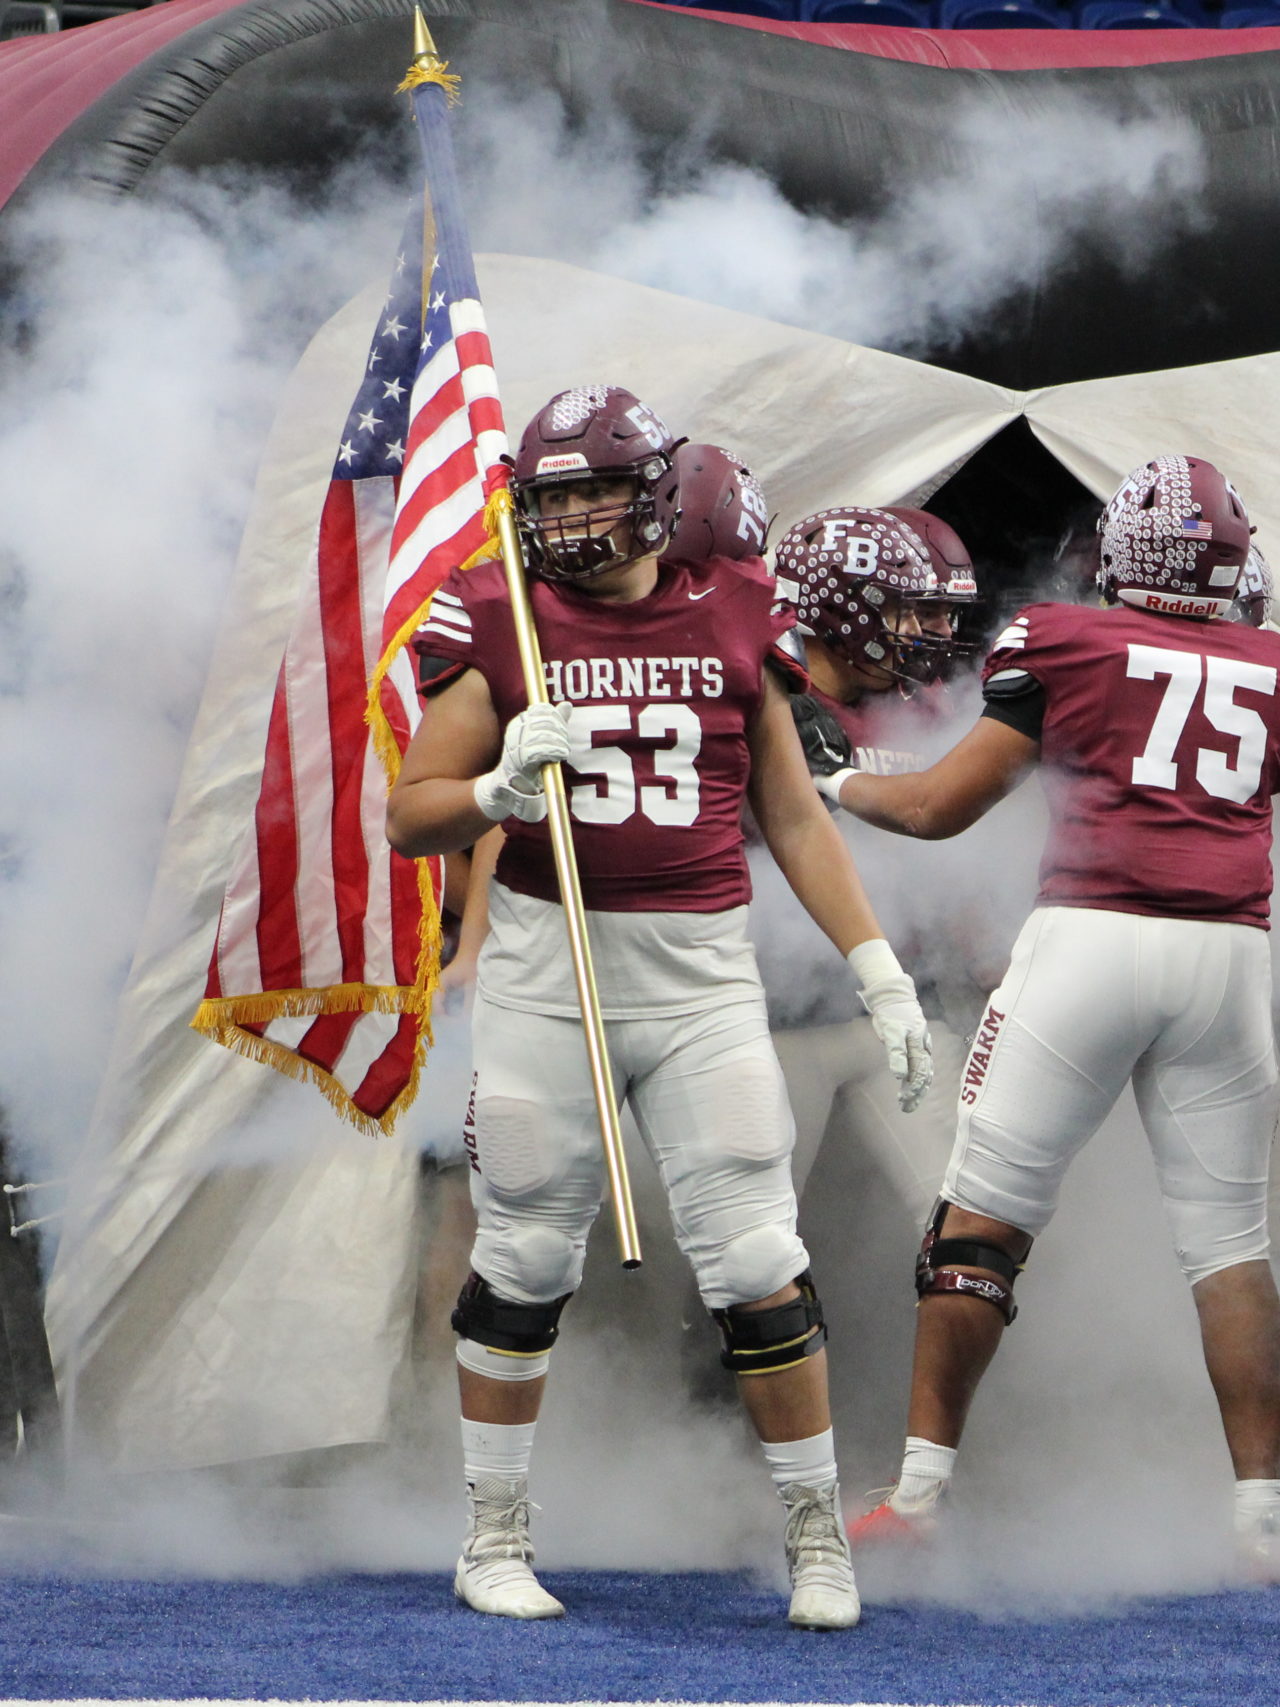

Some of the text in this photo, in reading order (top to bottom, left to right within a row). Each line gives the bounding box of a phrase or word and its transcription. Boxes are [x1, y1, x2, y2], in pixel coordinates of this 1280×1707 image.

[1146, 595, 1218, 615] Riddell
[543, 657, 724, 701] HORNETS
[1126, 643, 1278, 804] 75
[566, 703, 702, 826] 53
[961, 1005, 1006, 1105] SWARM
